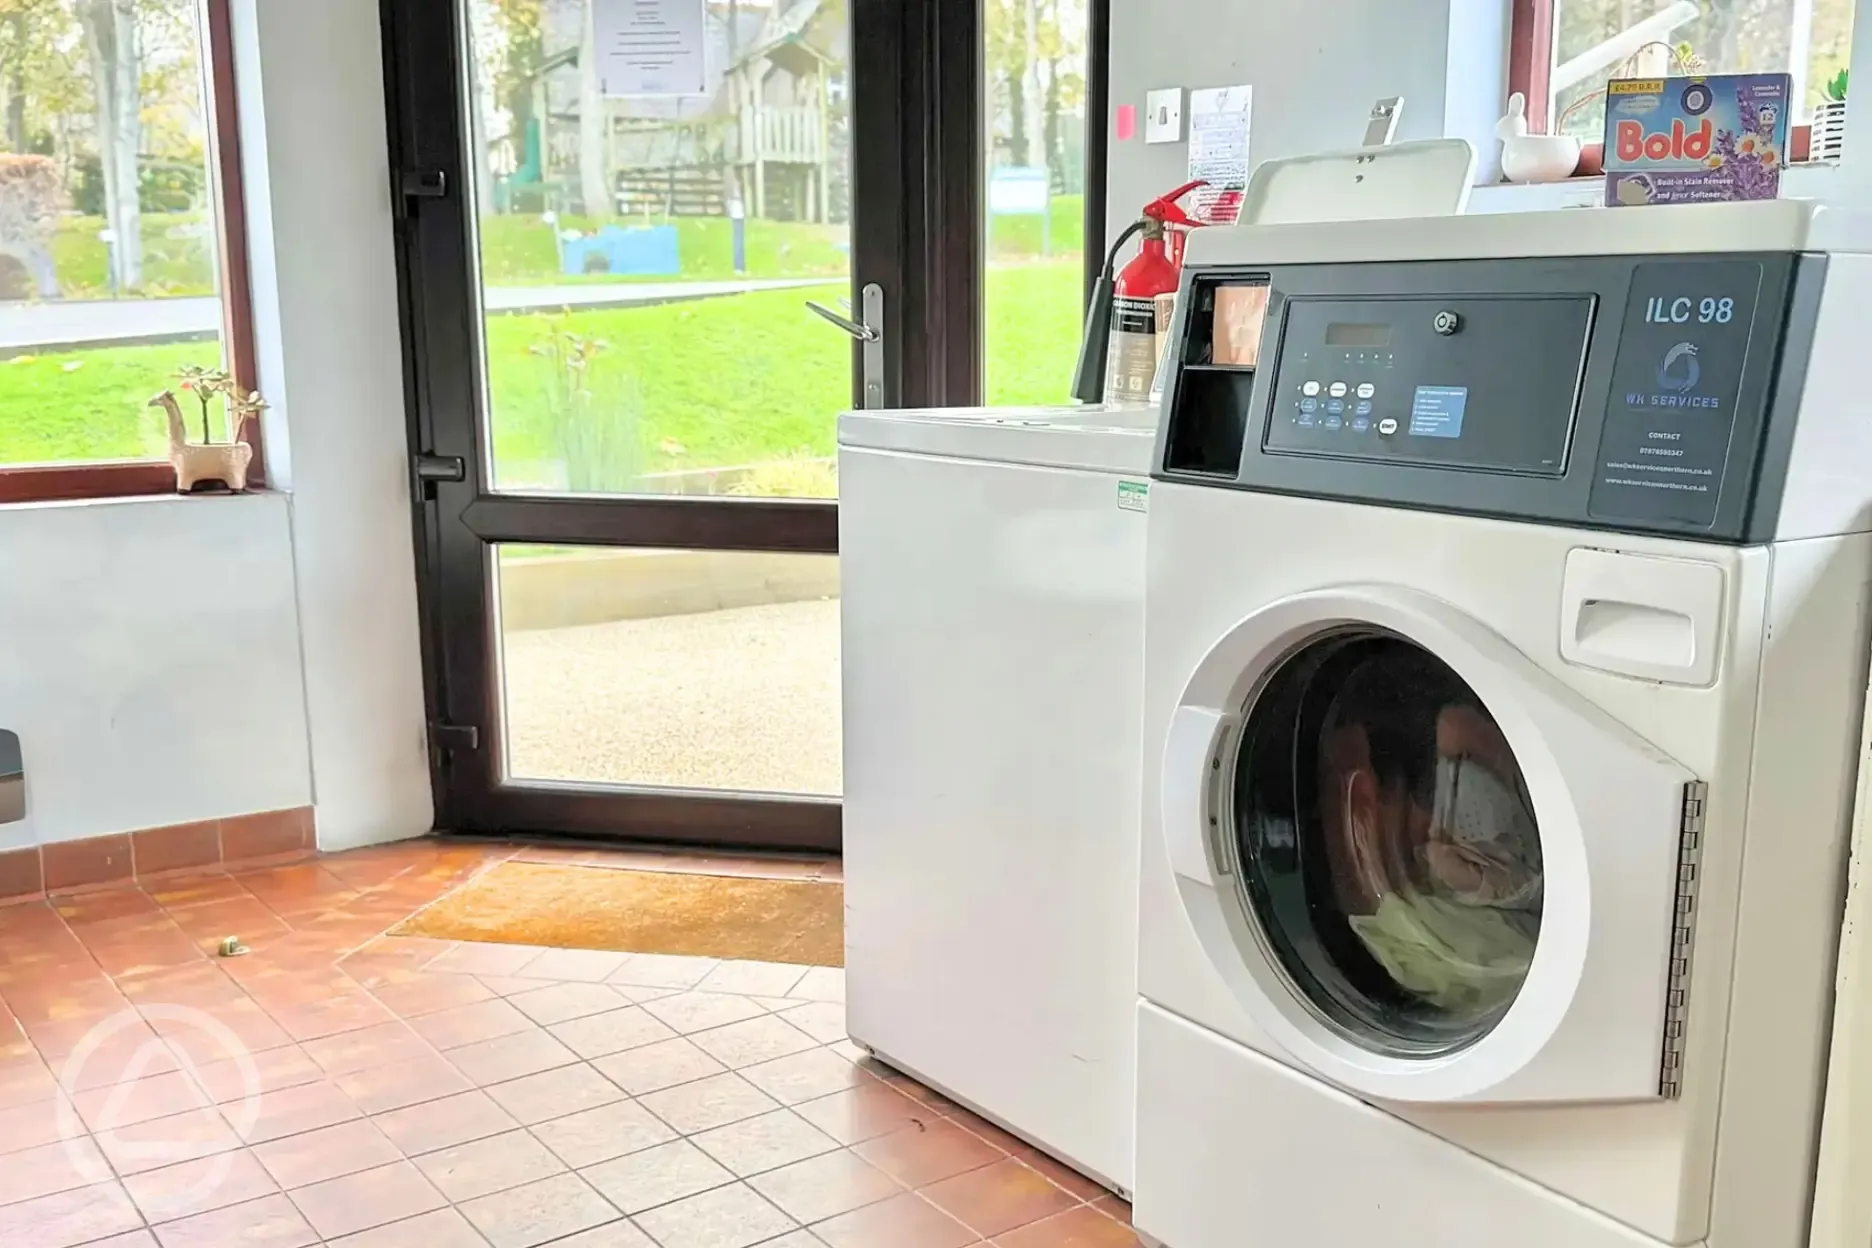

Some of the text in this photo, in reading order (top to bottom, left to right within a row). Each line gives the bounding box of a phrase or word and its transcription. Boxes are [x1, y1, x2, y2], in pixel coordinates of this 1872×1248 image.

[1762, 112, 1774, 121] 12
[1615, 118, 1713, 163] Bold
[1684, 178, 1702, 186] Stain
[1703, 177, 1734, 185] Remover
[1656, 191, 1670, 199] and
[1690, 190, 1721, 199] Softener
[1645, 297, 1734, 323] ILC 98
[1651, 395, 1719, 408] SERVICES
[1648, 431, 1681, 440] CONTACT
